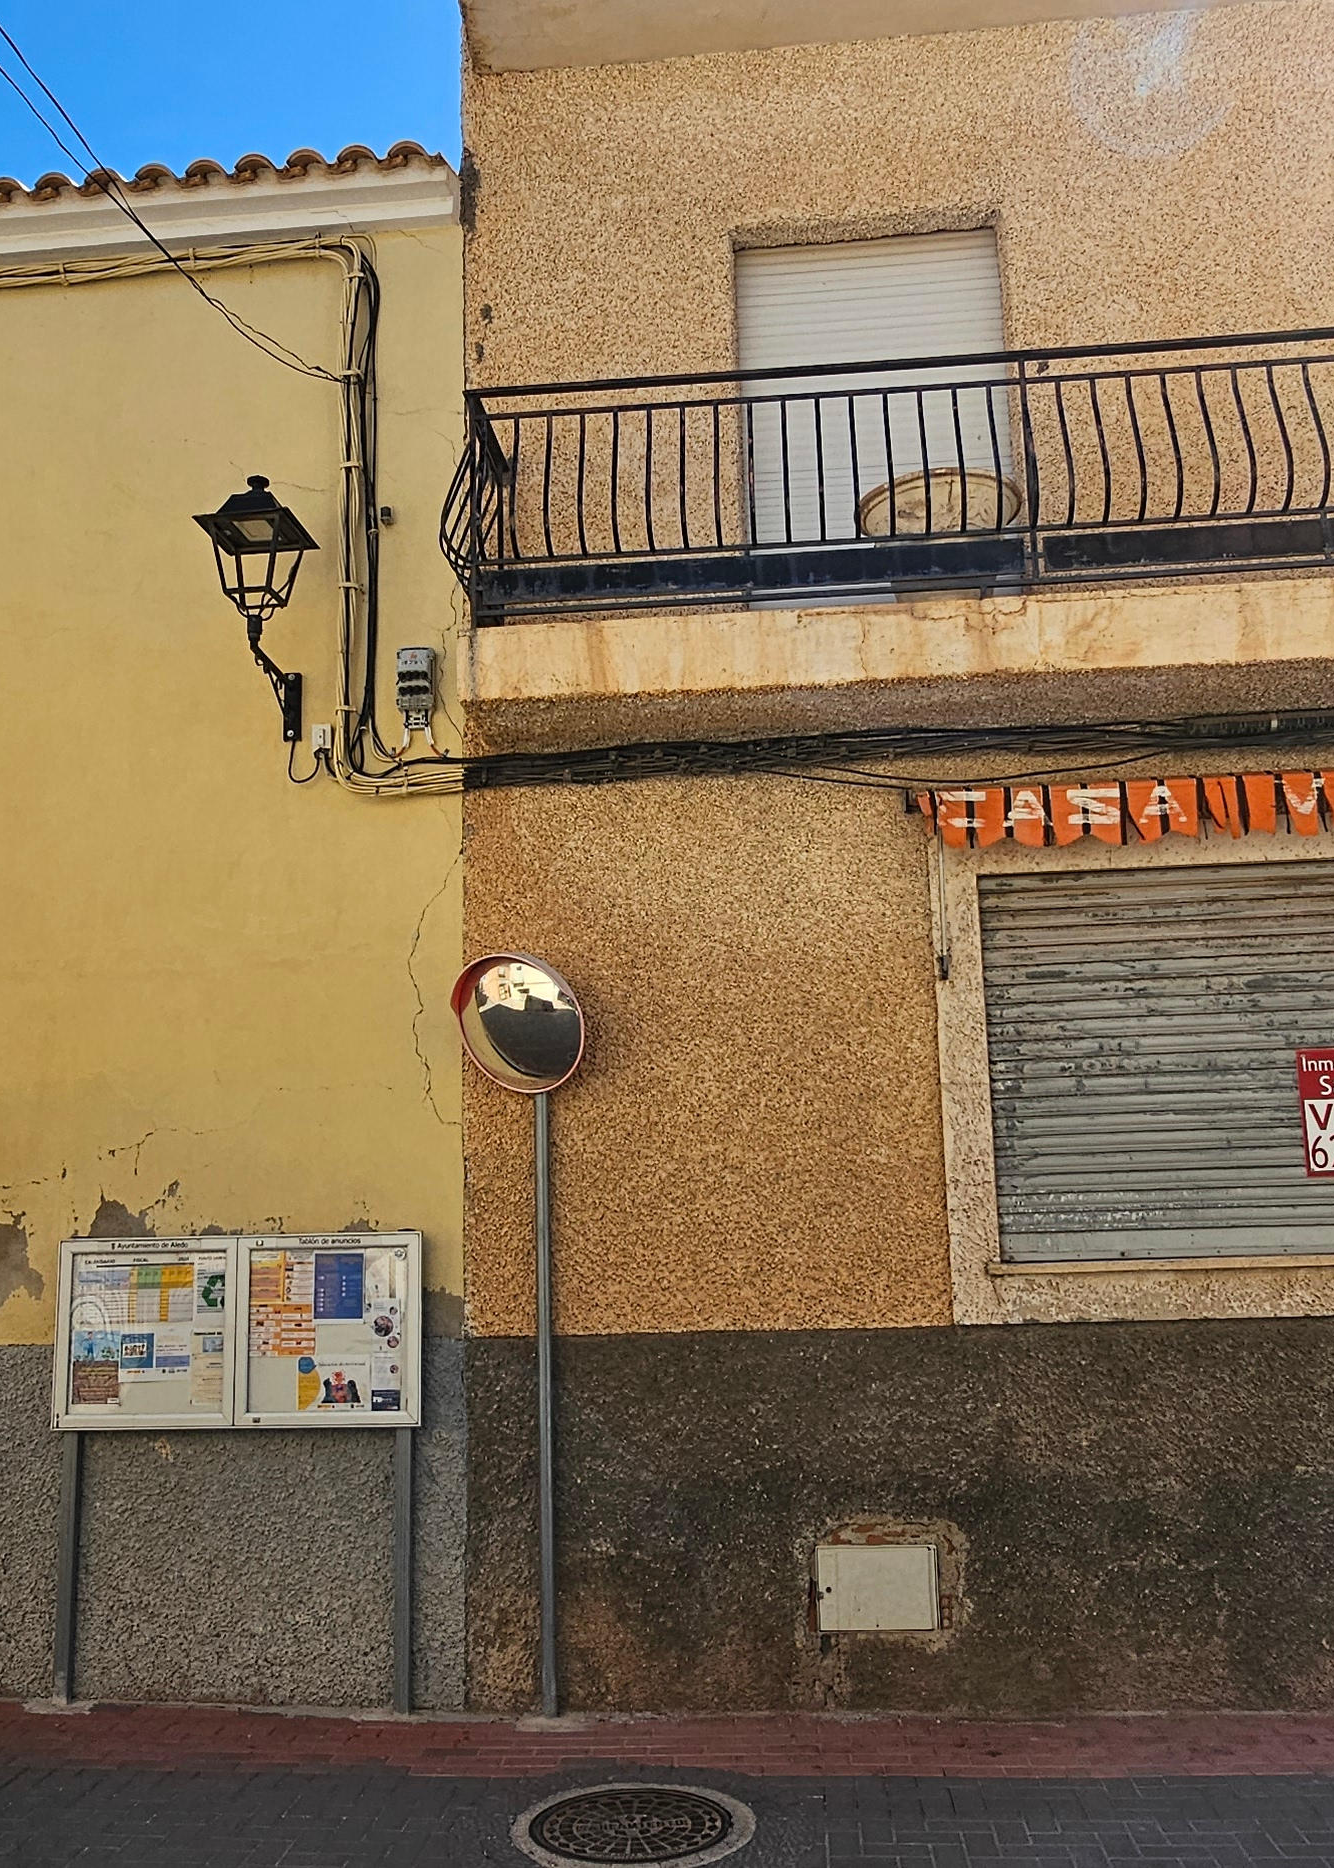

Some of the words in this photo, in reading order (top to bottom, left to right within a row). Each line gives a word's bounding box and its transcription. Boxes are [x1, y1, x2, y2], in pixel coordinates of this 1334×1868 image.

[937, 784, 1189, 829] CASA
[117, 1241, 160, 1250] Ayuntamiento
[161, 1241, 169, 1249] de
[320, 1237, 330, 1245] de
[331, 1237, 362, 1245] anuncios
